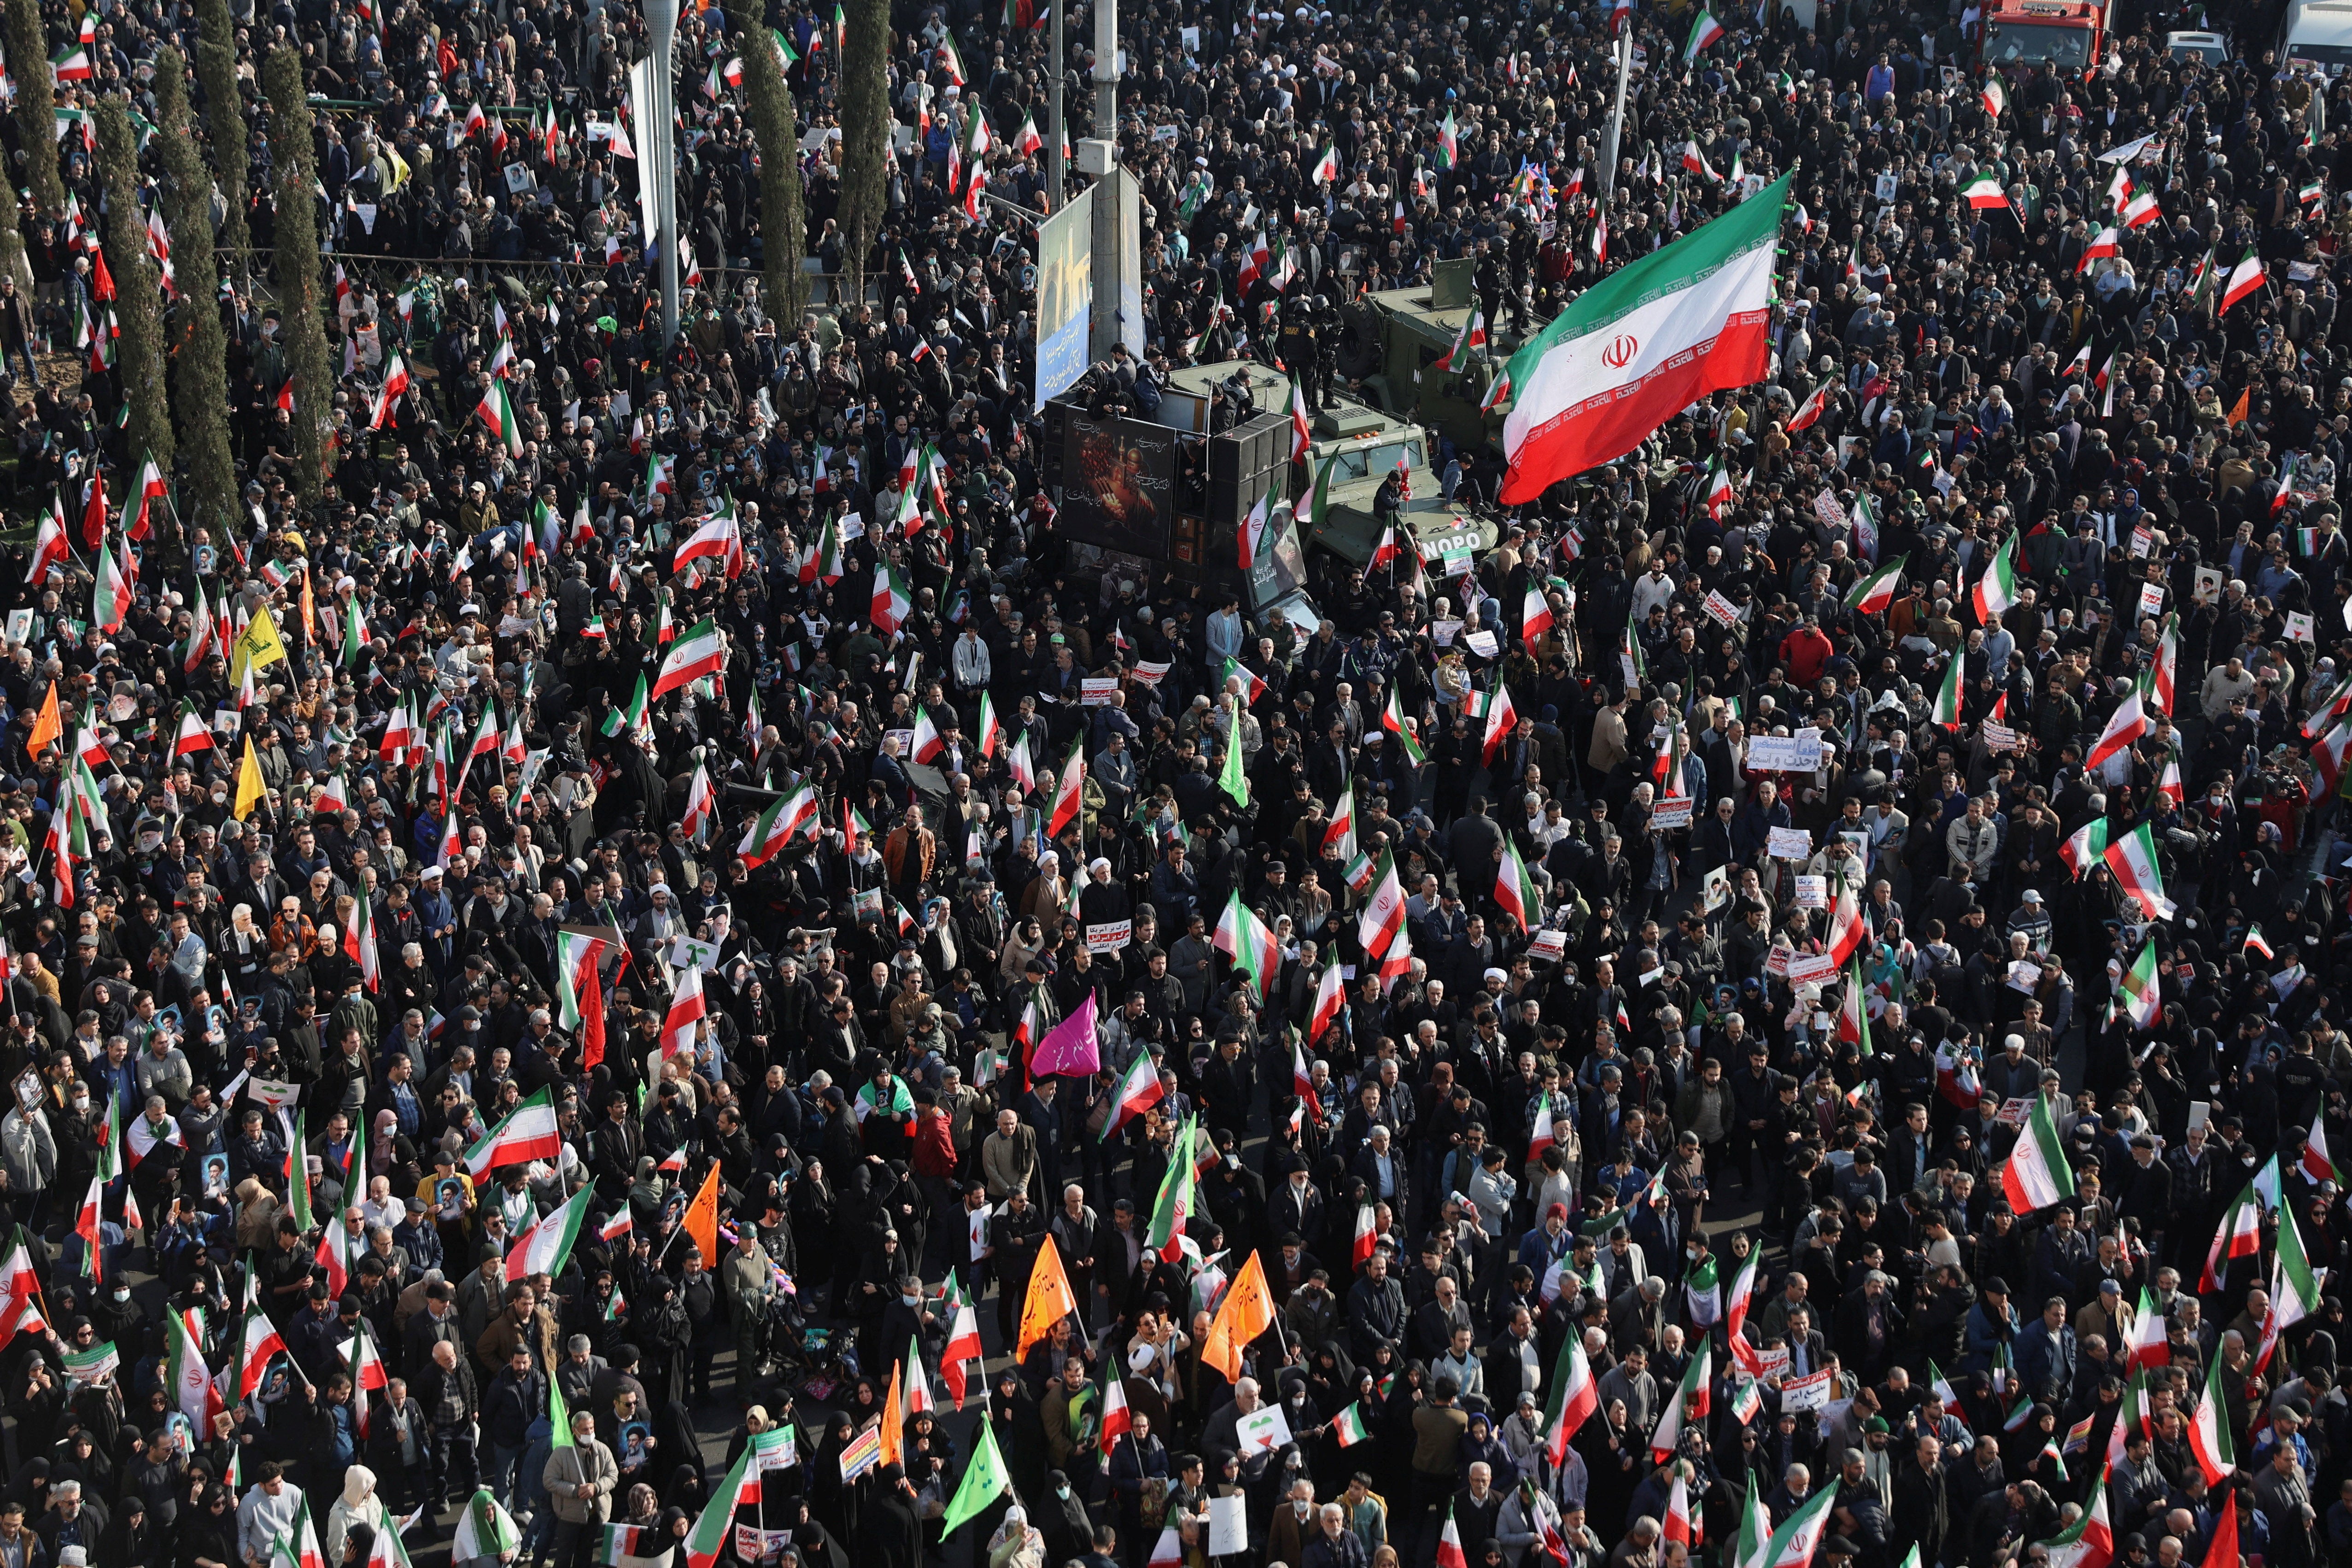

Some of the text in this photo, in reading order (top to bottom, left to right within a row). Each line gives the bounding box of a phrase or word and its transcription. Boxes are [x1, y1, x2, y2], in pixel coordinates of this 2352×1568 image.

[1360, 437, 1382, 448] پلیس
[1422, 532, 1480, 558] NOPO
[1784, 755, 1818, 771] وحدت
[1090, 942, 1109, 951] انگلیس
[2286, 1074, 2311, 1082] OTHERS
[1772, 1358, 1787, 1368] مرگ
[1789, 1383, 1826, 1402] مطیع امر
[758, 1445, 784, 1457] آخ
[769, 1453, 792, 1464] ایستاده
[847, 1464, 860, 1477] DOWN
[859, 1456, 871, 1469] WITH
